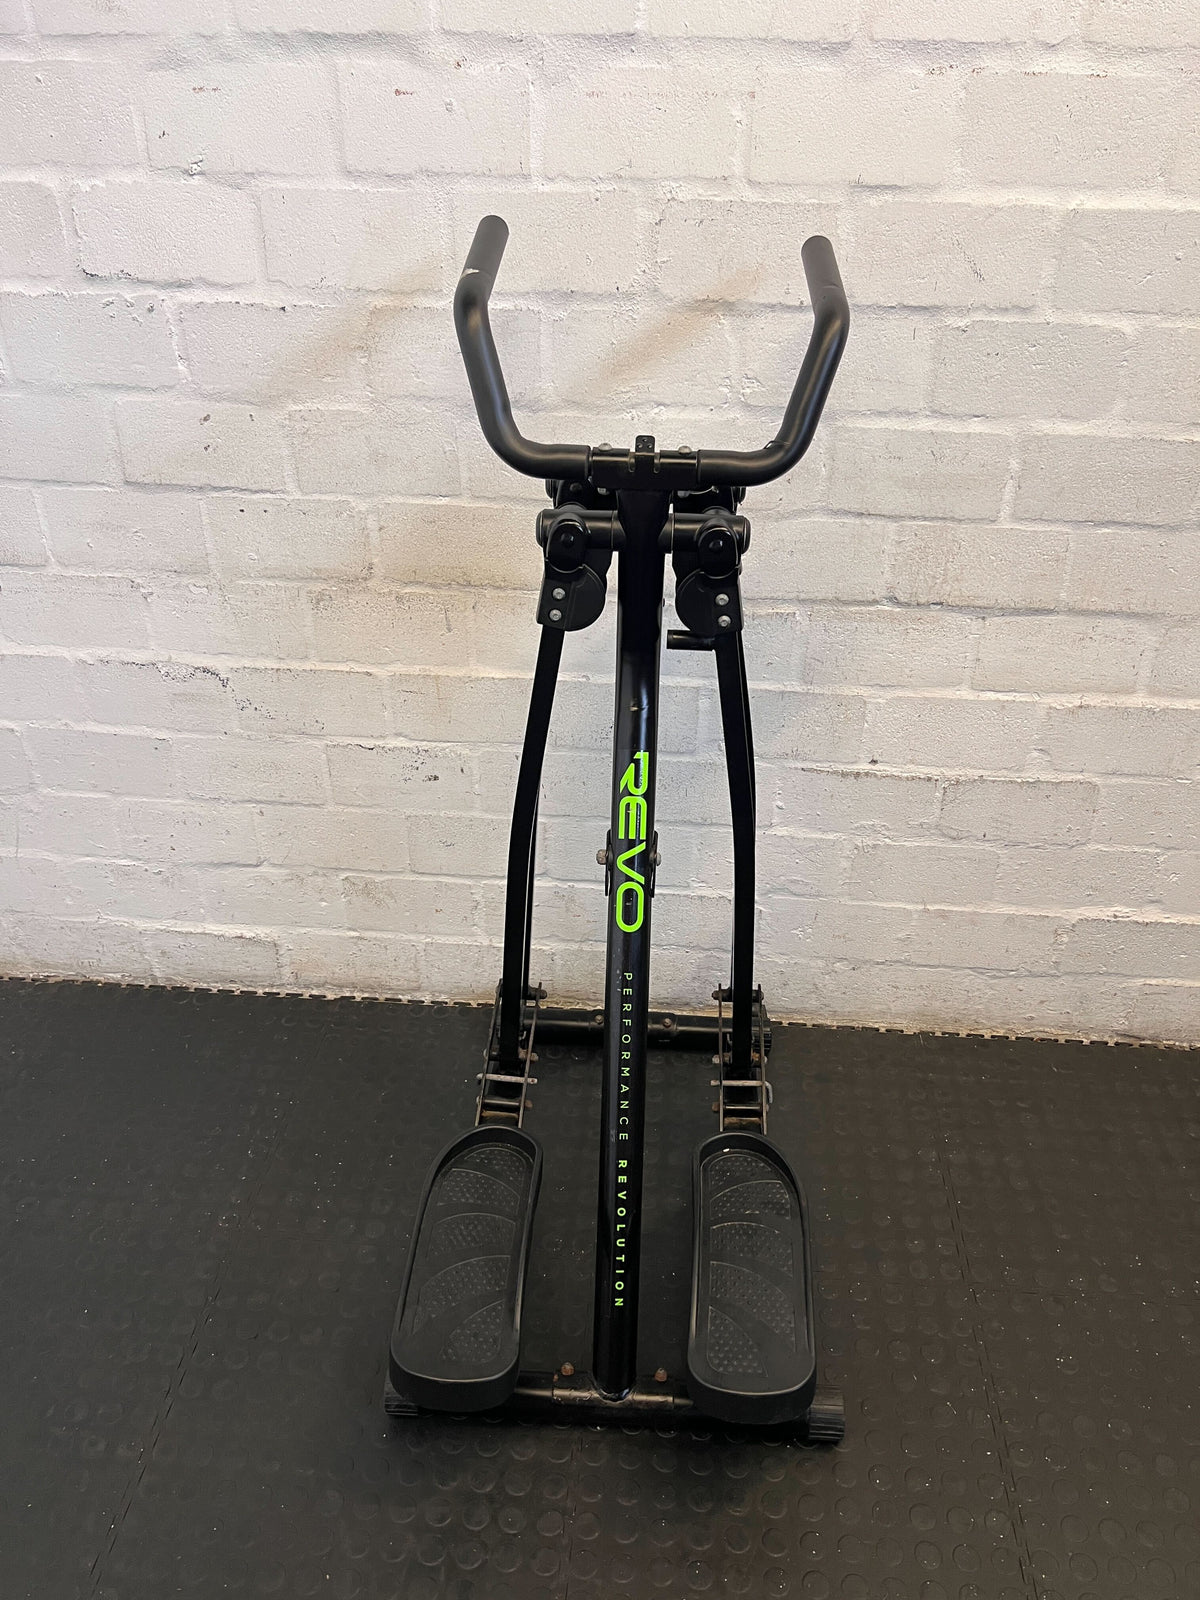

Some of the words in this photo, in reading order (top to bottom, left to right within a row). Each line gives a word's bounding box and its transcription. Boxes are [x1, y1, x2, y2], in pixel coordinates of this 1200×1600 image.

[616, 752, 649, 933] REVO
[619, 972, 633, 1141] PERFORMANCE
[614, 1159, 628, 1307] REVOLUTION
